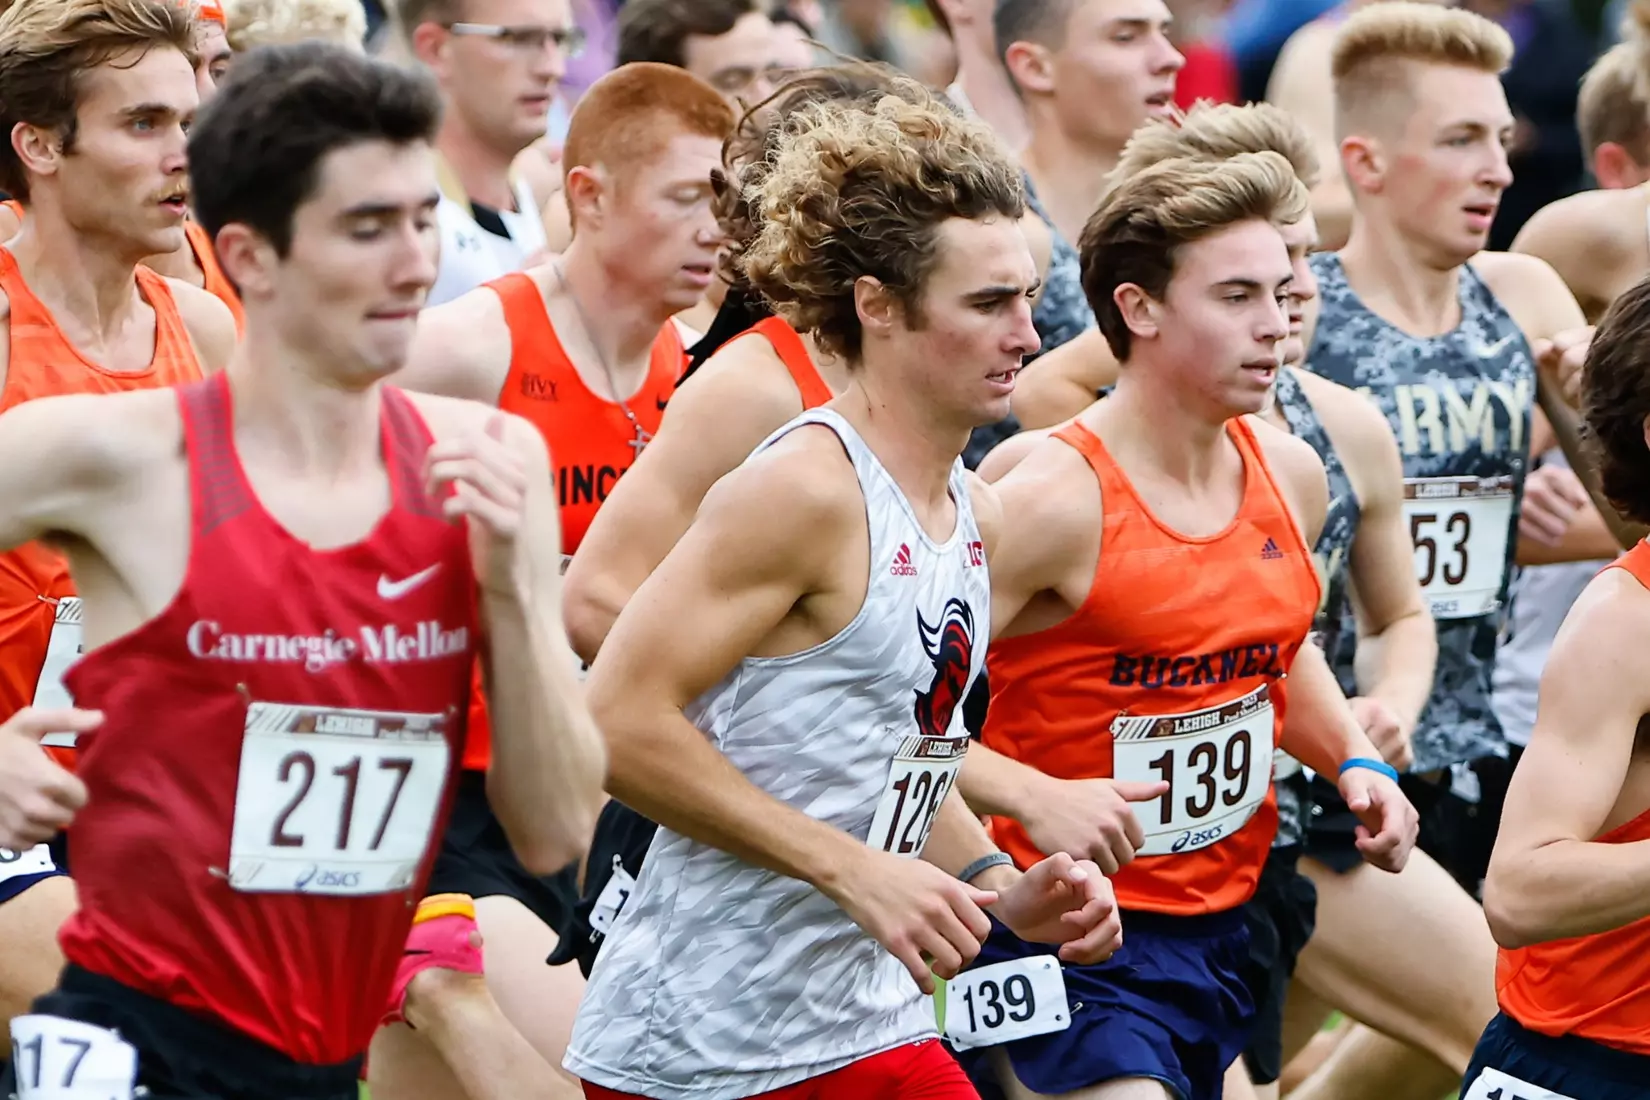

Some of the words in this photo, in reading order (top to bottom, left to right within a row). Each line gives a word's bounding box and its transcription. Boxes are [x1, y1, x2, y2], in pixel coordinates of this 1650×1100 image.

[1354, 379, 1529, 455] RMY
[1410, 511, 1471, 587] 53
[187, 620, 355, 673] Carnegie
[360, 620, 467, 662] Mellon
[1174, 711, 1221, 735] LEHIGH
[270, 750, 413, 851] 217
[1149, 729, 1251, 825] 139
[1190, 824, 1223, 847] asics
[963, 974, 1035, 1033] 139
[13, 1033, 92, 1089] 17
